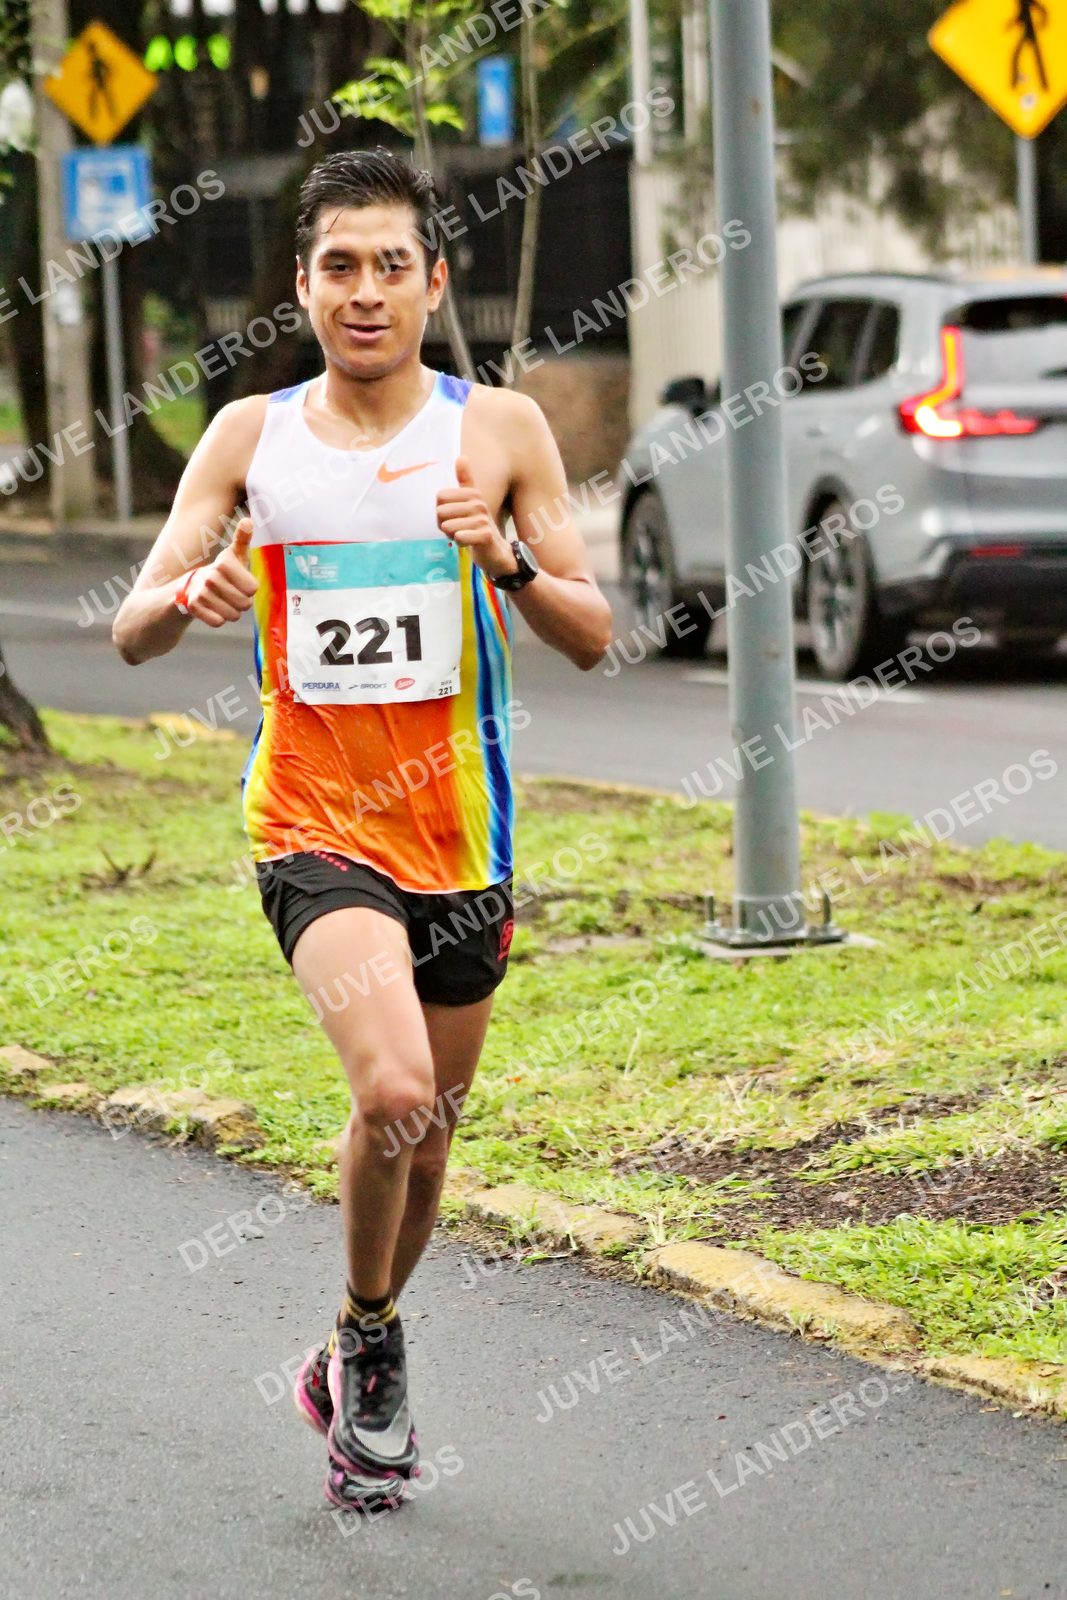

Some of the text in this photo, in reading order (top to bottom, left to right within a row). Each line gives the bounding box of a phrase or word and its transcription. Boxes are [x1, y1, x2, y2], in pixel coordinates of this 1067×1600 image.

[316, 614, 422, 666] 221
[302, 681, 341, 690] PERDURA
[438, 686, 453, 696] 221
